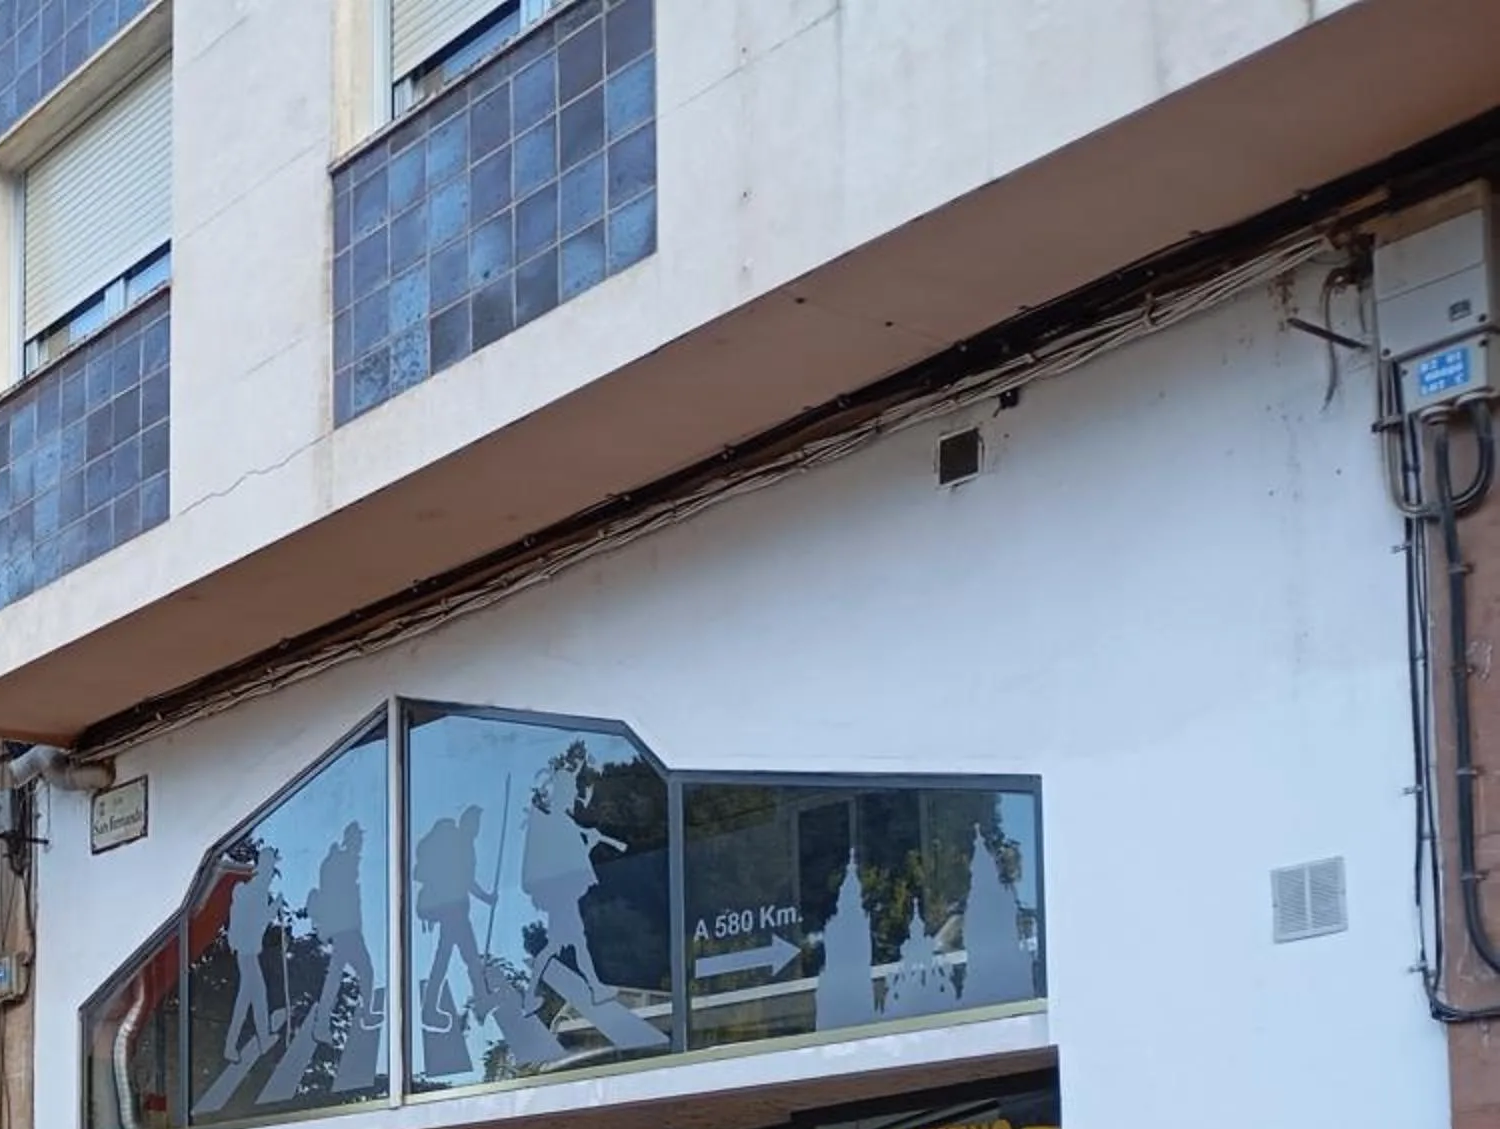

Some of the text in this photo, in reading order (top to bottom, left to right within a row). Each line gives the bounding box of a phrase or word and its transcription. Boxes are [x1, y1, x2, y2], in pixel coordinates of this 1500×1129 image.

[693, 904, 804, 942] A 580 Km.
